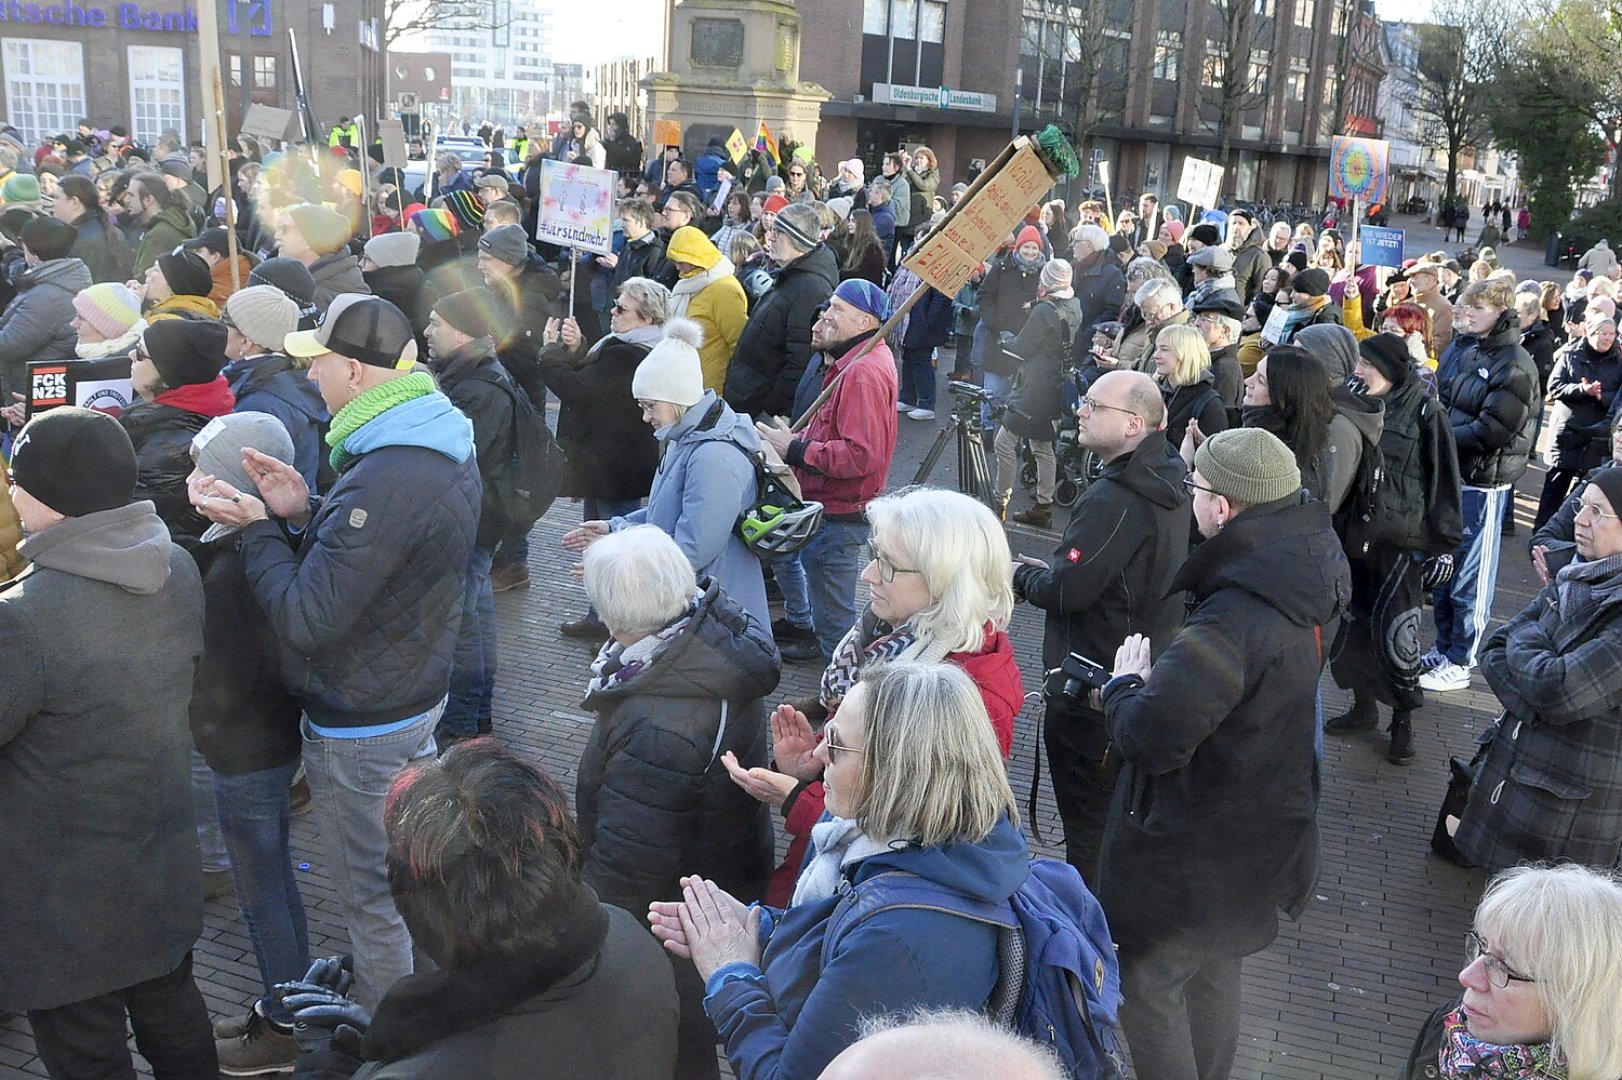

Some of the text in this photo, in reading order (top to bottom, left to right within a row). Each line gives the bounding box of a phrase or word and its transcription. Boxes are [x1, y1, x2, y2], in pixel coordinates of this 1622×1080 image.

[893, 87, 939, 103] Oldenburgische
[949, 92, 982, 106] Landesbank
[540, 220, 608, 246] #wirsindmehr
[1362, 229, 1403, 241] NIE WIEDER
[1366, 238, 1399, 249] IST JETZT!
[32, 373, 67, 387] FCK
[32, 386, 67, 399] NZS
